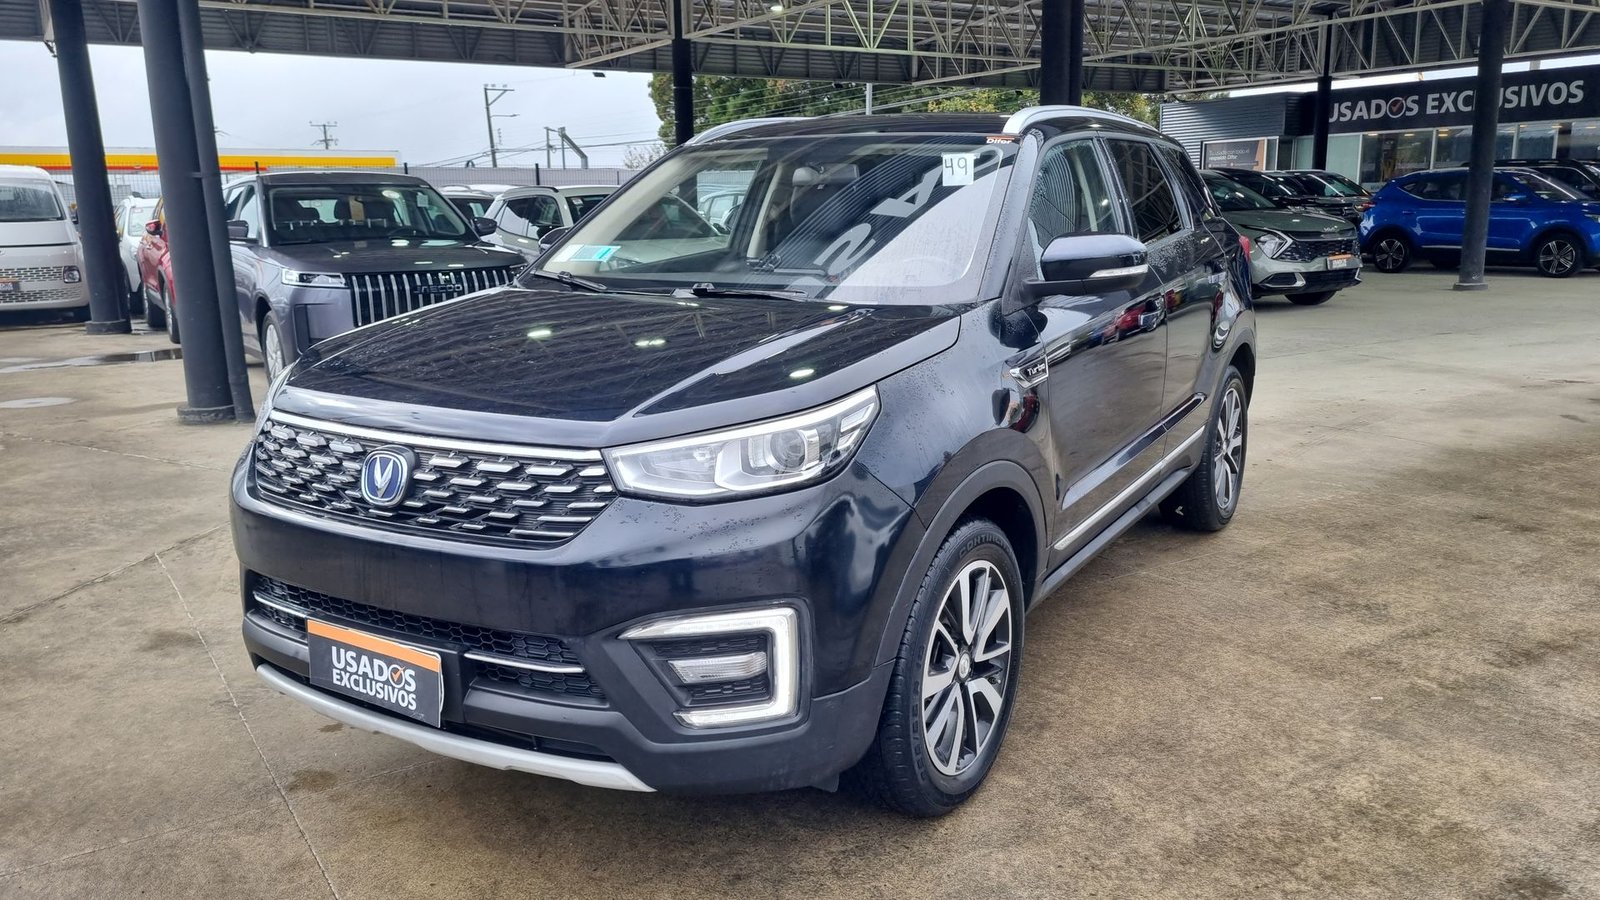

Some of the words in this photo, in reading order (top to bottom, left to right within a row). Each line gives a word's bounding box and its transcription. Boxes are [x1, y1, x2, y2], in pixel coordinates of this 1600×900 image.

[1426, 80, 1584, 115] EXCSIVOS
[944, 157, 968, 176] 49
[331, 645, 417, 693] USADOS
[332, 668, 417, 711] EXCLUSIVOS
